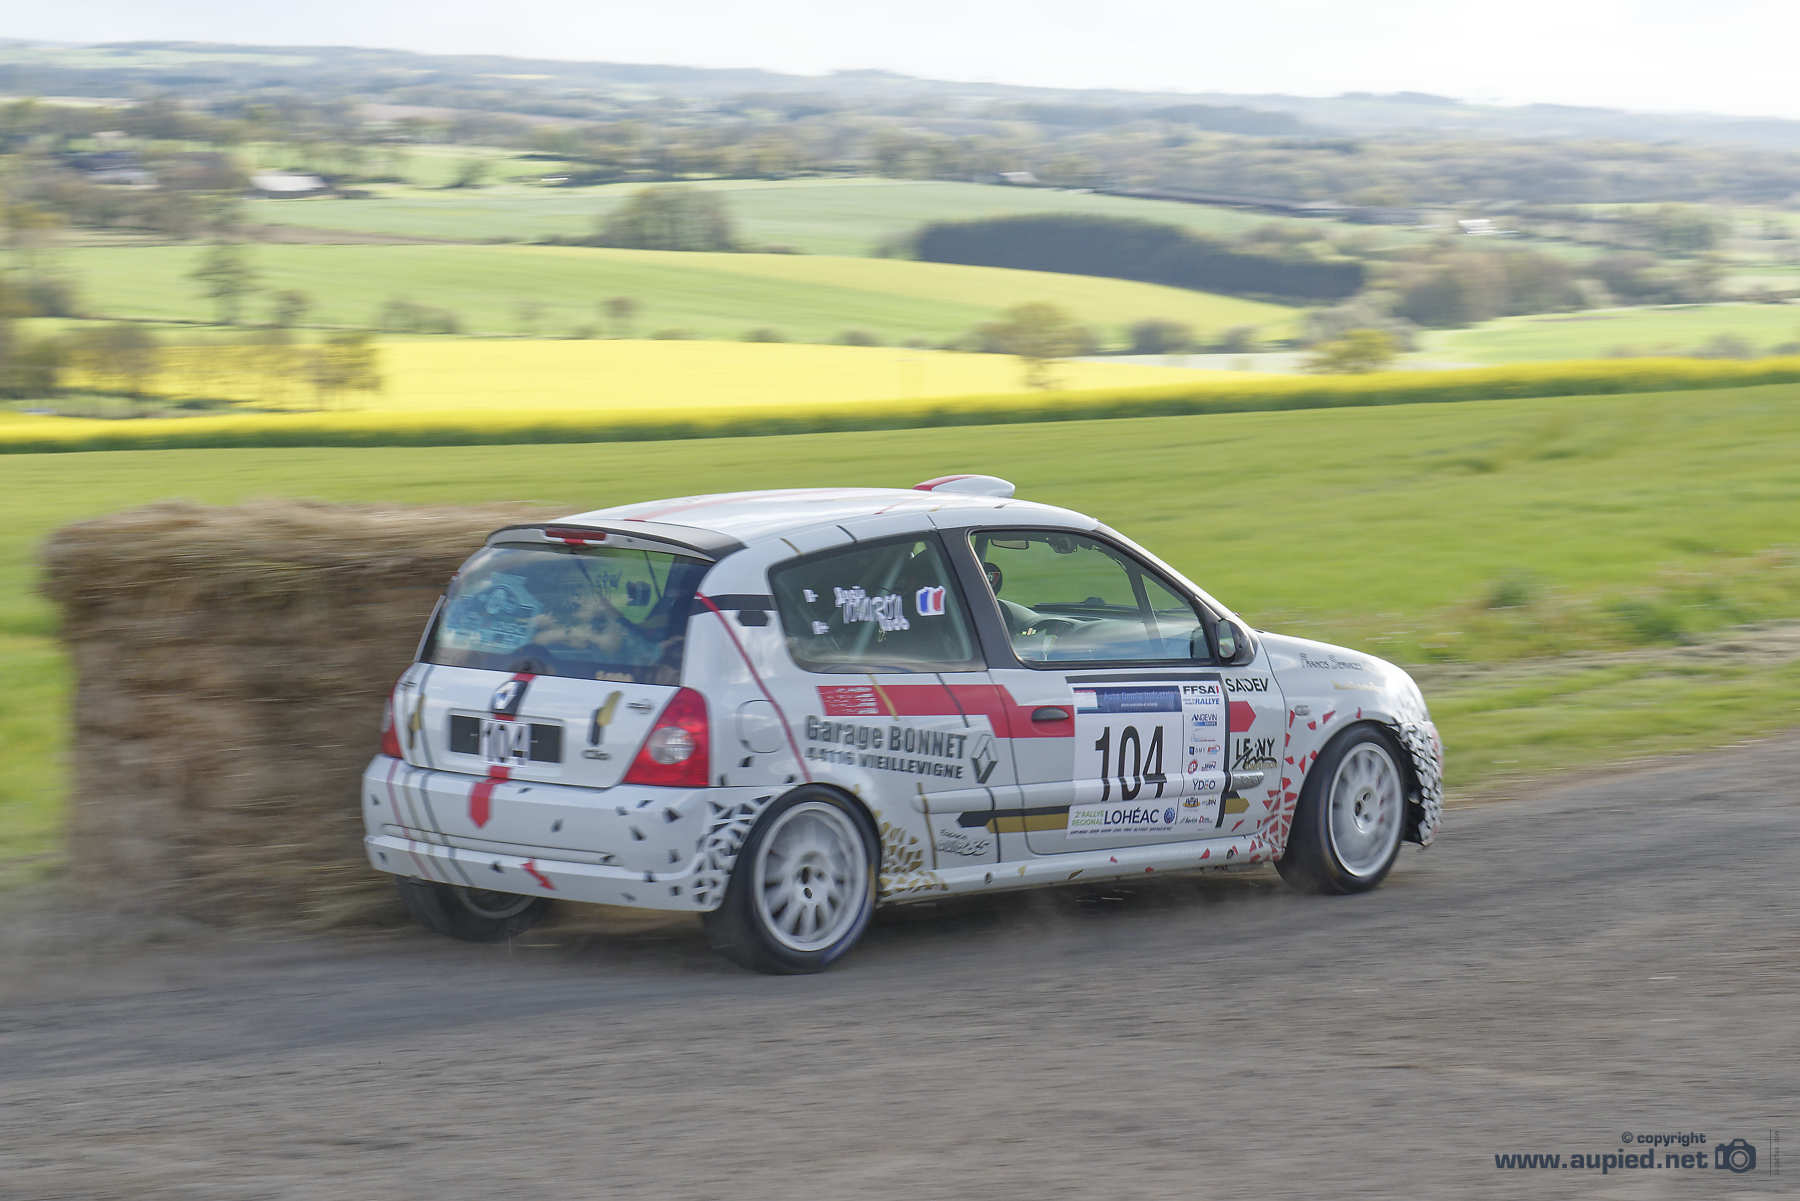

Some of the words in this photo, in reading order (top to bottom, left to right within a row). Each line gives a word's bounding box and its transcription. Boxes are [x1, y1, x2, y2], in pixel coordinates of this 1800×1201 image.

[1183, 685, 1217, 695] FFSA
[1225, 677, 1269, 693] SADEV
[805, 714, 883, 750] Garage
[888, 725, 968, 760] BONNET
[858, 752, 964, 780] VIEILLEVIGNE
[1095, 725, 1168, 803] 104
[1104, 807, 1160, 825] LOHÉAC
